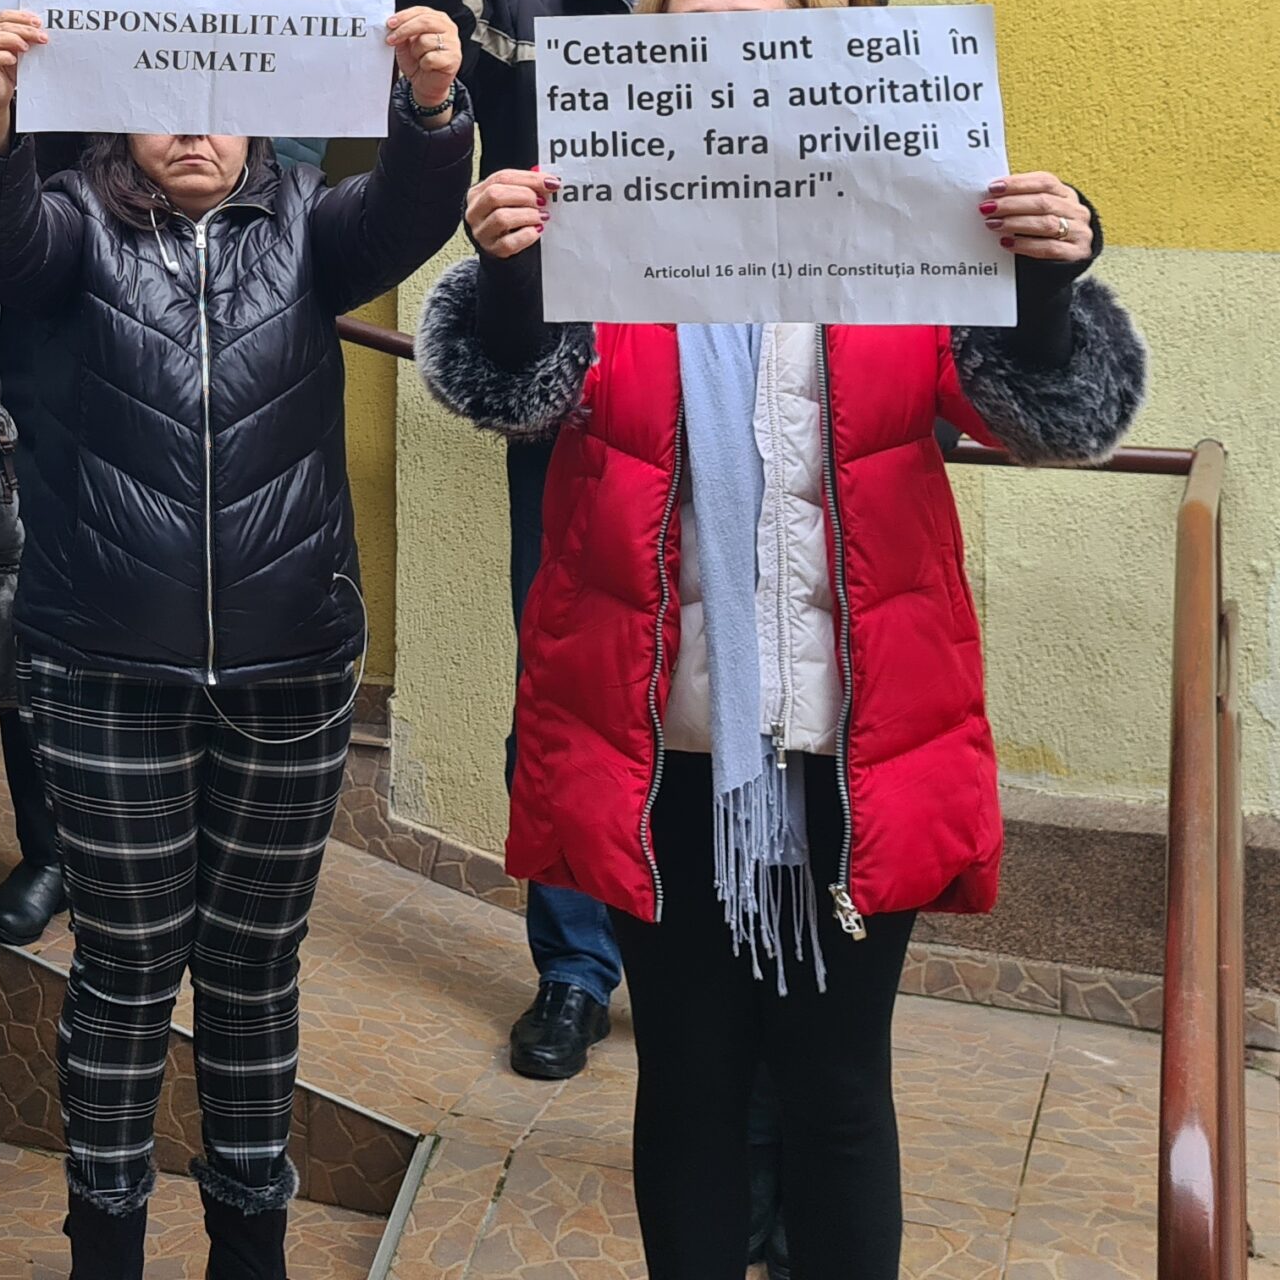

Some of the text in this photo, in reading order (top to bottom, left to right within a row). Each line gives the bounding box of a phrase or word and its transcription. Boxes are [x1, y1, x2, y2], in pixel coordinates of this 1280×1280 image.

[47, 9, 366, 38] RESPONSABILITATILE
[133, 50, 276, 73] ASUMATE
[546, 28, 978, 66] "Cetatenii sunt egali în
[547, 76, 983, 116] fata legii si a autoritatilor
[550, 122, 989, 163] publice, fara privilegii si
[624, 172, 845, 202] discriminari".
[644, 264, 710, 279] Articolul
[716, 265, 733, 277] 16
[738, 263, 767, 276] alin
[771, 262, 792, 278] (1)
[798, 263, 823, 276] din
[921, 260, 998, 276] României
